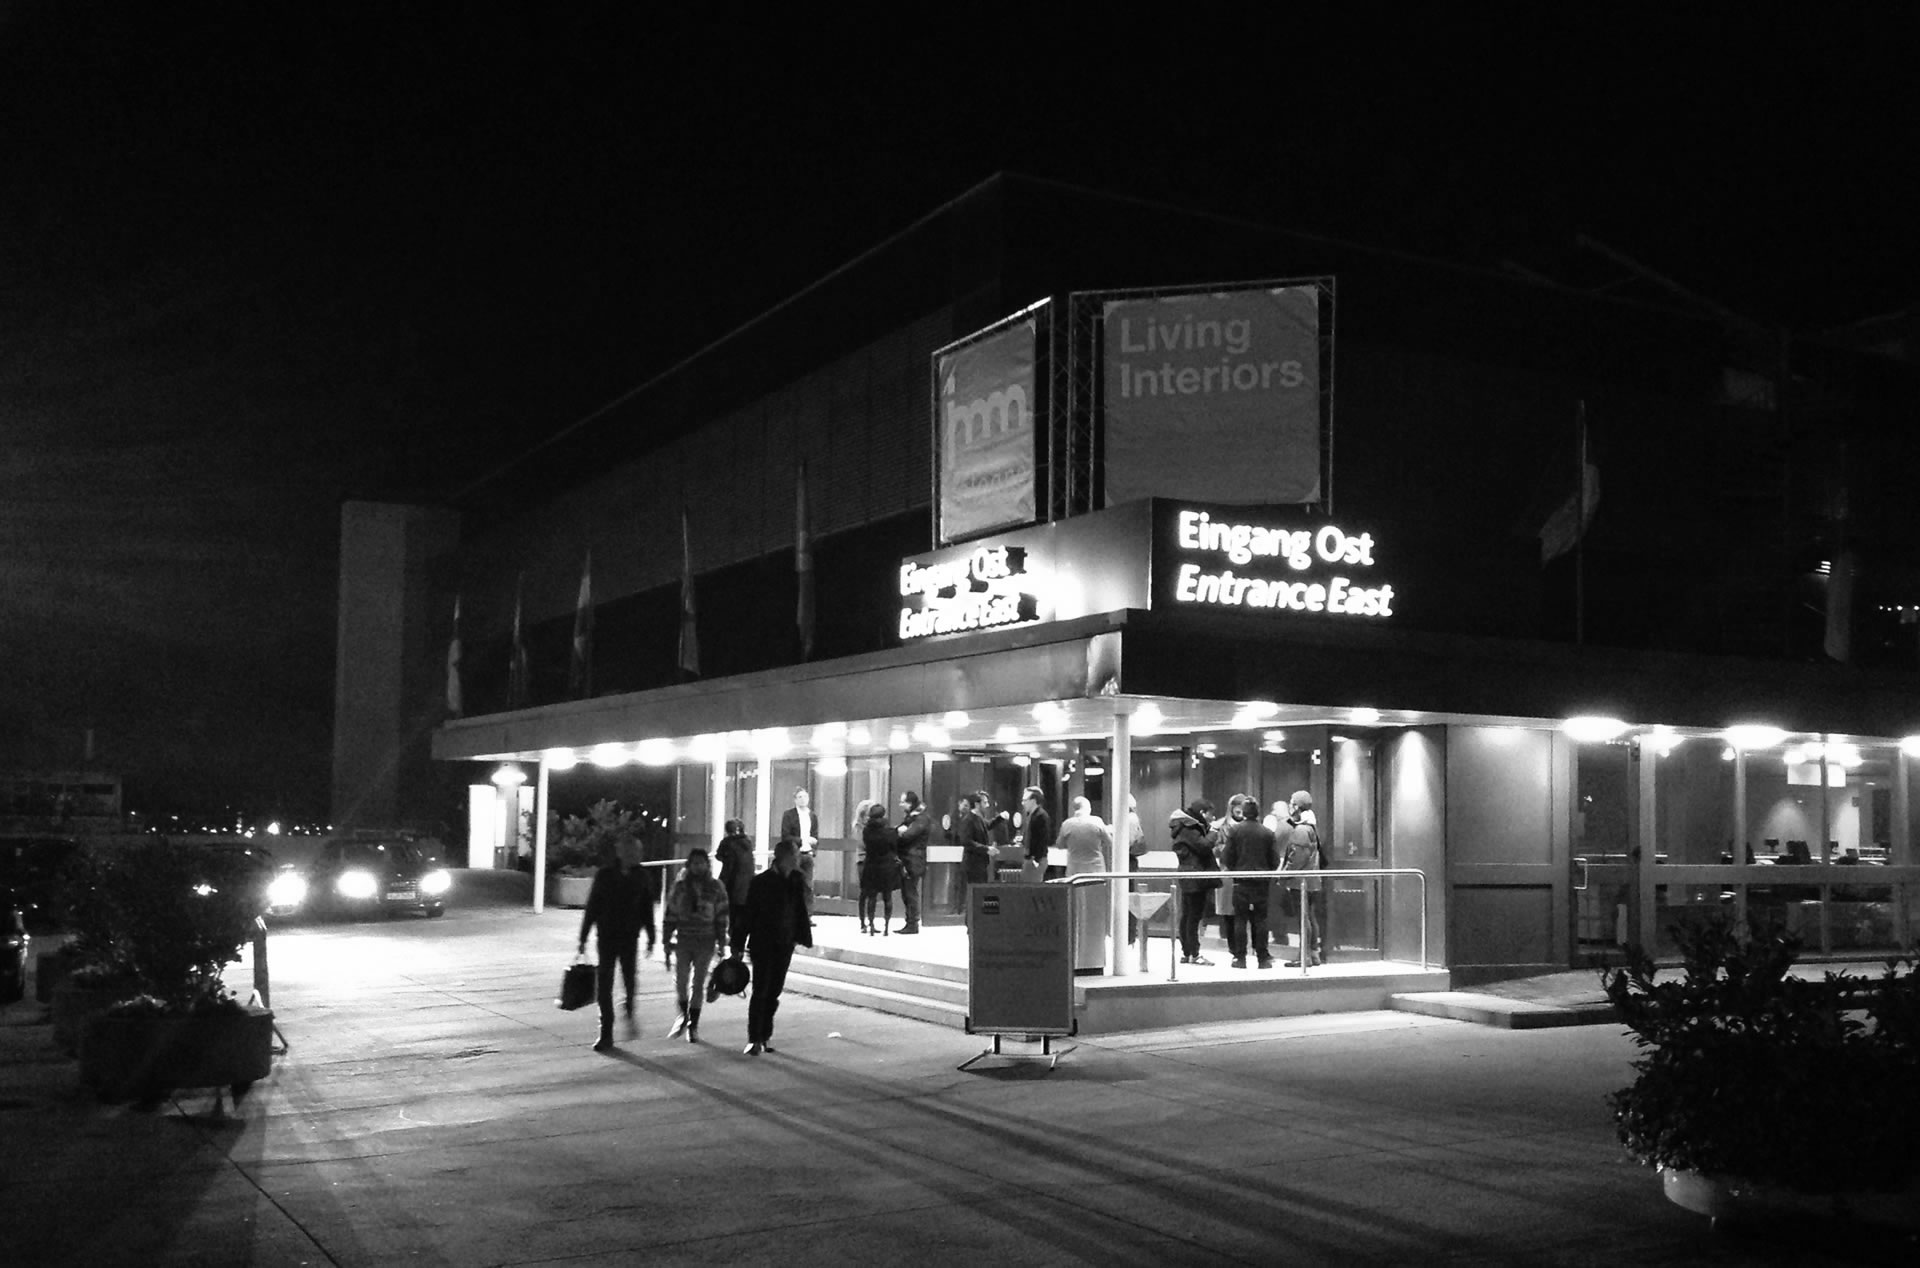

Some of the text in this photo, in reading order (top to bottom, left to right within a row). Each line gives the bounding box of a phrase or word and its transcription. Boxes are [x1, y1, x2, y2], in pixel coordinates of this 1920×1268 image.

[1120, 314, 1251, 354] Living
[1120, 357, 1304, 398] Interiors
[1180, 511, 1375, 570] Eingang Ost
[1176, 564, 1395, 617] Entrance East
